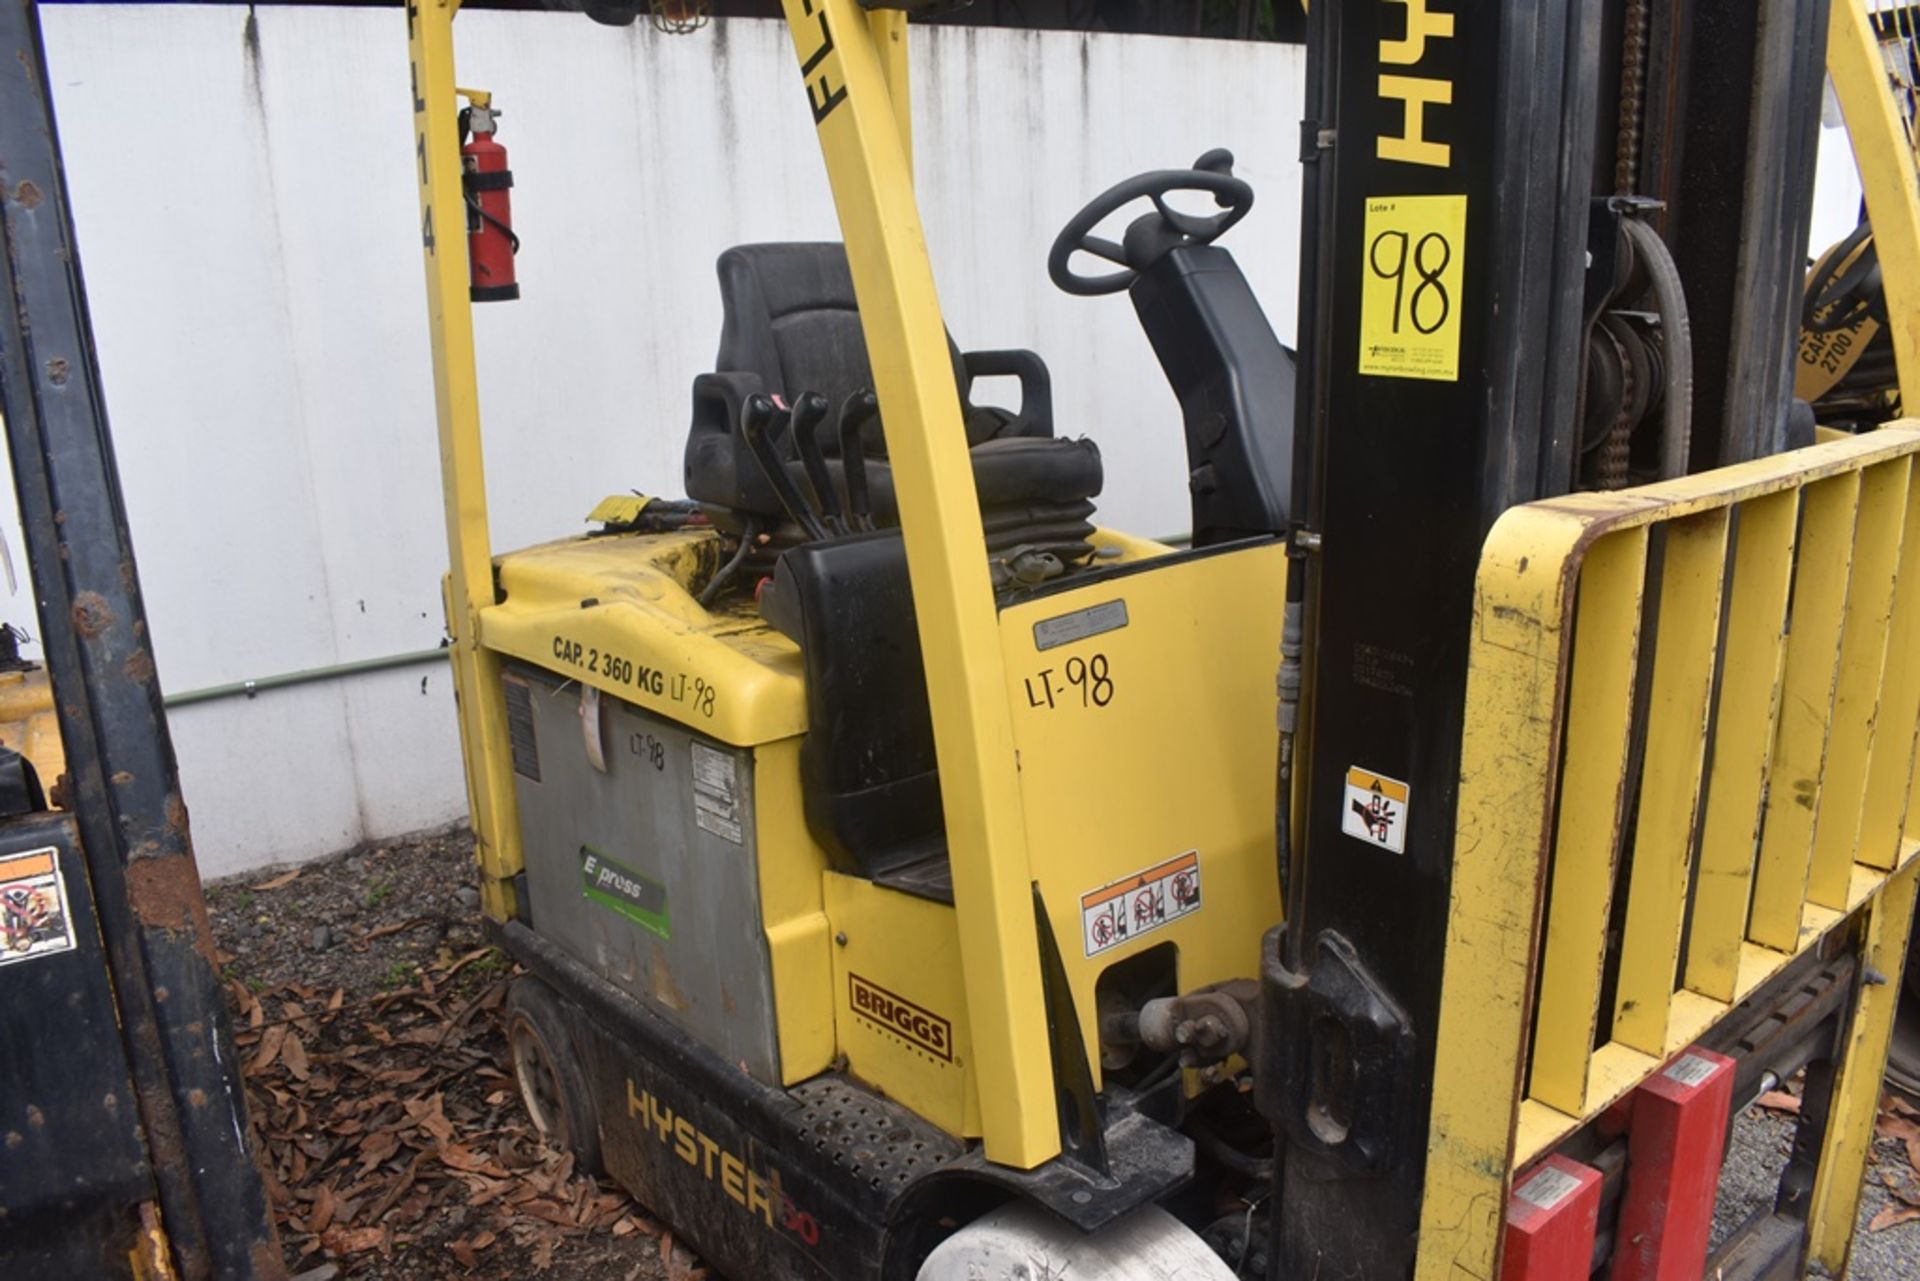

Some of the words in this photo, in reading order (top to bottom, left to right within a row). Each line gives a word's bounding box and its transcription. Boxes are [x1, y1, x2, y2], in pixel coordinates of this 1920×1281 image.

[1369, 203, 1388, 213] Lote
[1370, 230, 1450, 335] 98
[1801, 331, 1831, 366] CAP.
[1820, 332, 1853, 375] 2700
[553, 635, 584, 667] CAP.
[588, 648, 598, 673] 2
[602, 653, 632, 685] 360
[637, 665, 664, 696] KG
[1024, 653, 1114, 709] LT-98
[671, 672, 716, 719] LT-98
[630, 732, 665, 772] LT-98
[855, 983, 945, 1049] BRIGGS
[626, 1076, 776, 1230] HYSTER
